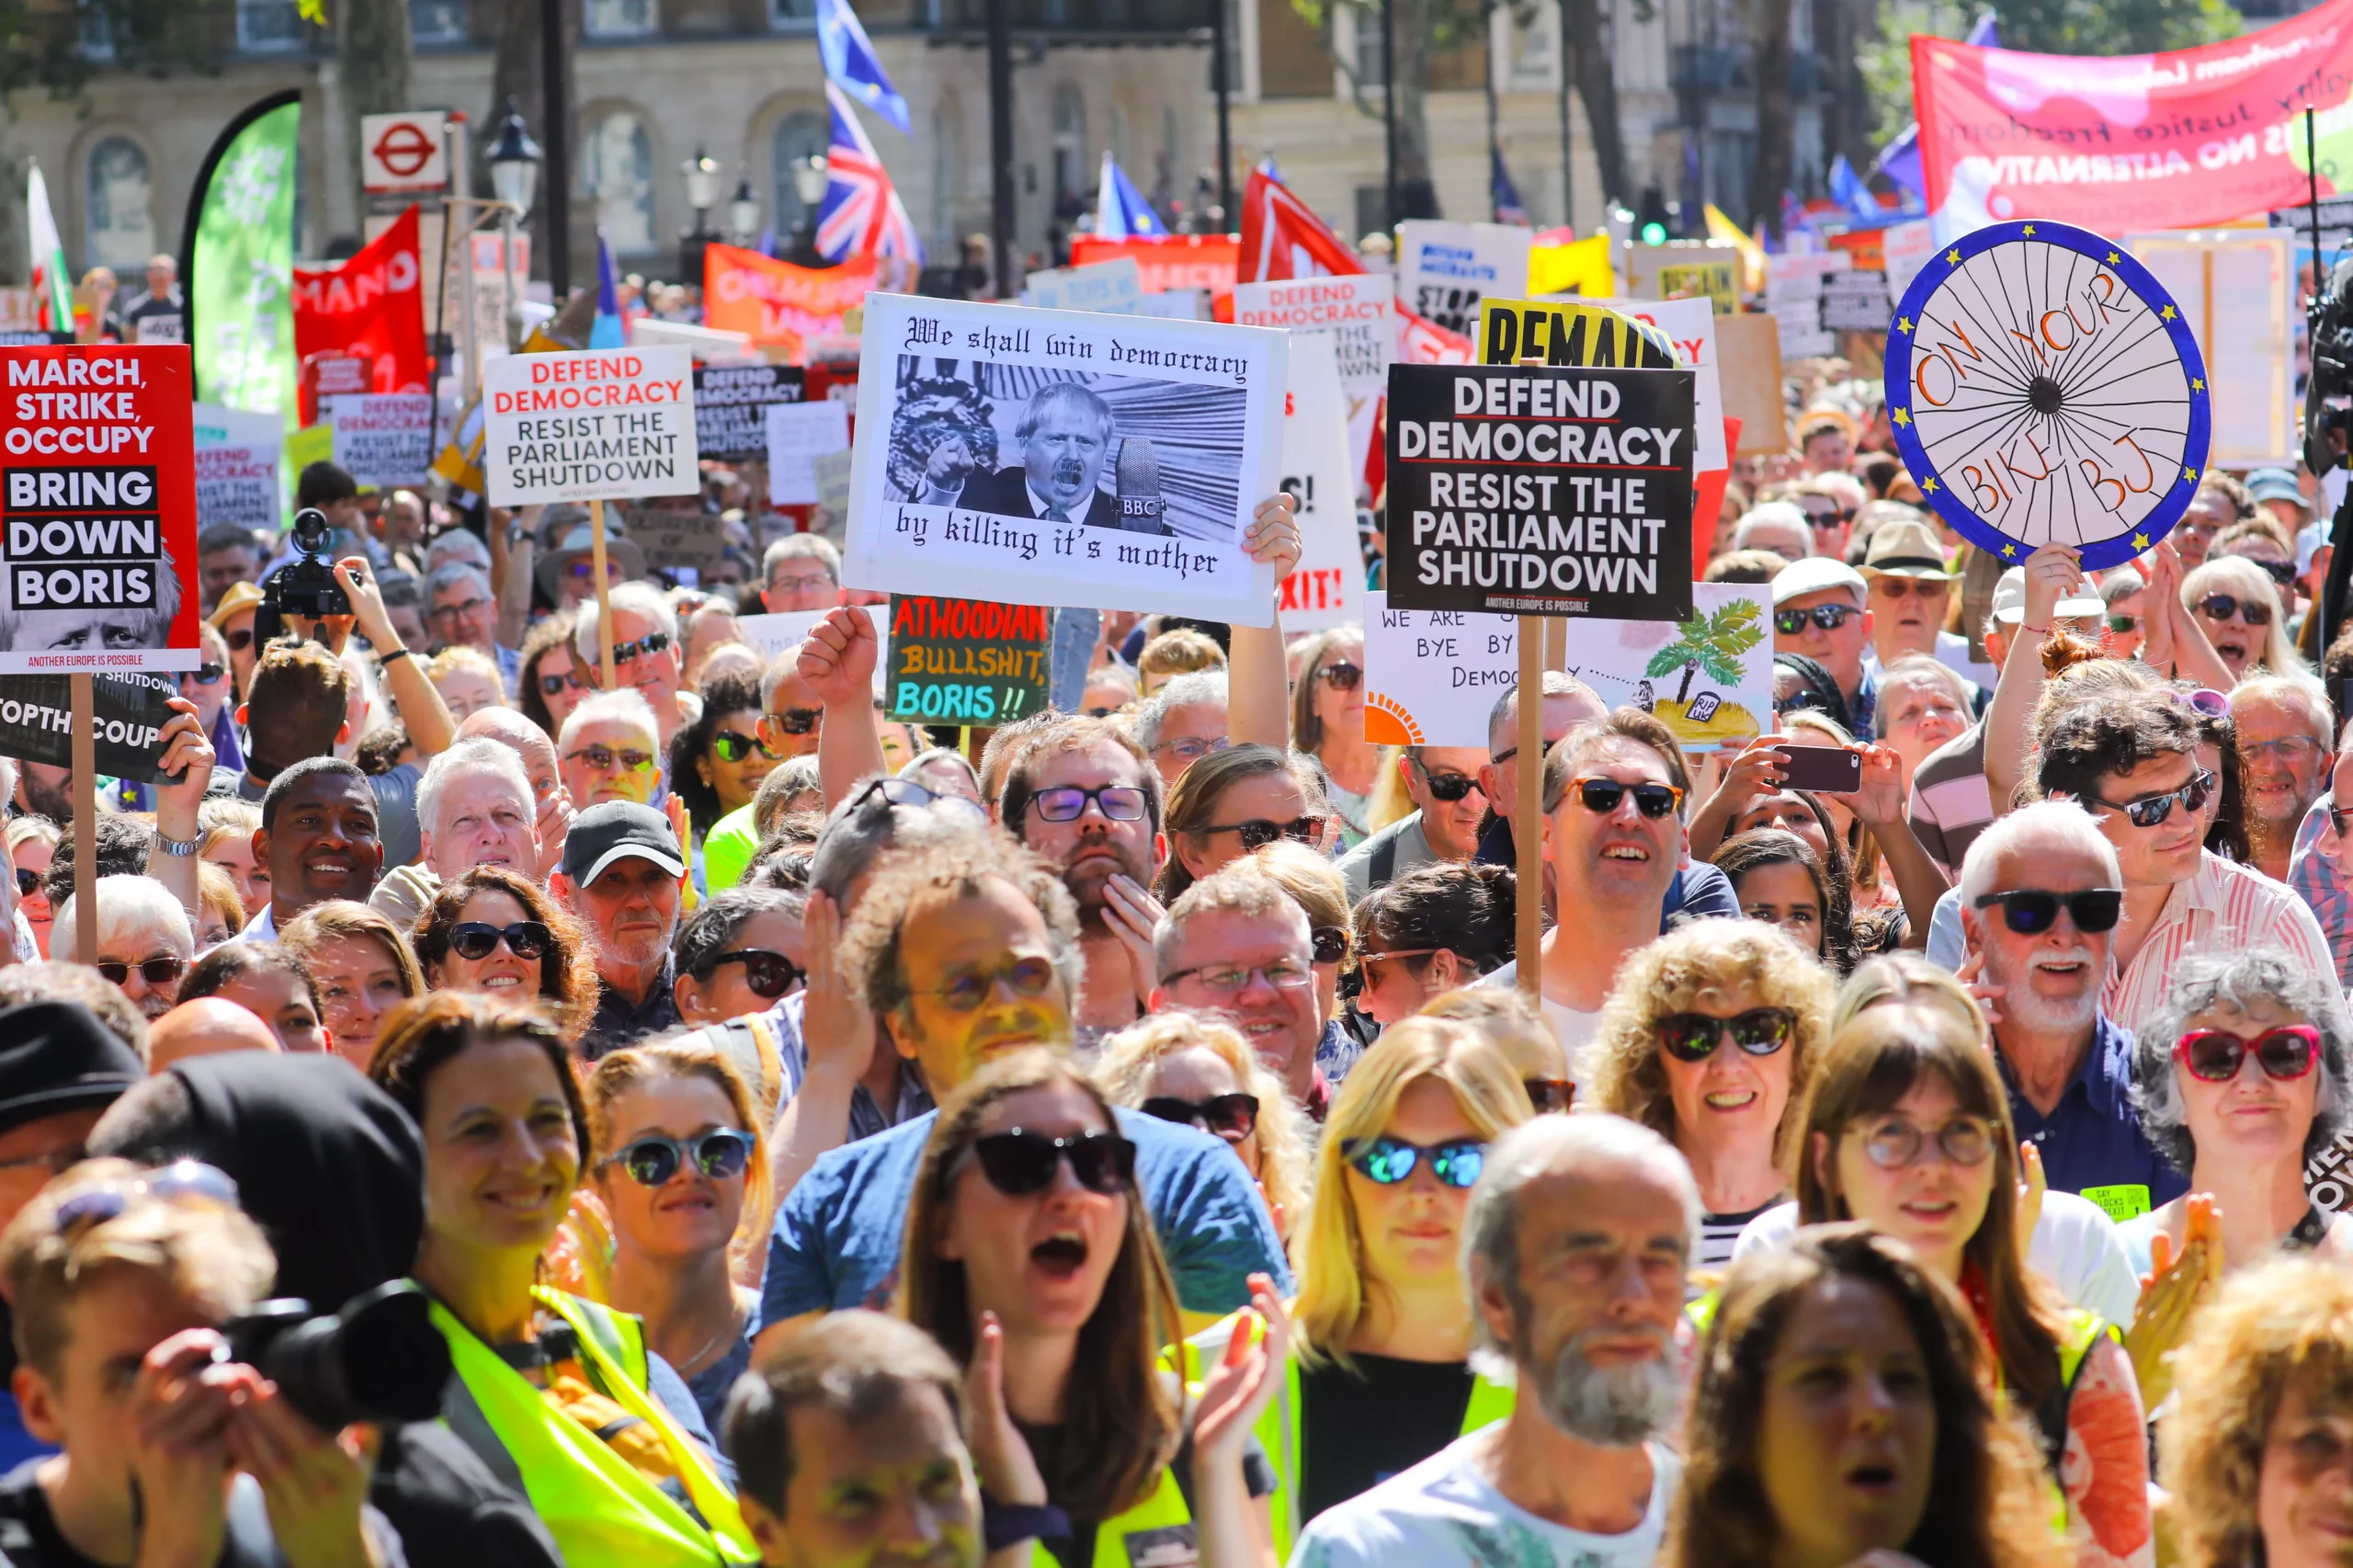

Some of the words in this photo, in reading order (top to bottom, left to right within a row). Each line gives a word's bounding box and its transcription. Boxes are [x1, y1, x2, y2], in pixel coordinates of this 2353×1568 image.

[1269, 282, 1356, 306] DEFEND
[1243, 301, 1386, 327] DEMOCRACY
[904, 315, 954, 351] We
[967, 324, 1031, 359] shall
[1045, 333, 1094, 359] win
[1109, 338, 1248, 385] democracy
[1916, 320, 1983, 407] ON
[2010, 273, 2131, 369] YOUR
[8, 358, 147, 389] MARCH,
[531, 356, 642, 384] DEFEND
[703, 368, 777, 389] DEFEND
[16, 392, 141, 423] STRIKE,
[494, 380, 683, 414] DEMOCRACY
[694, 383, 801, 406] EMOCRACY
[1454, 377, 1621, 419] DEFEND
[5, 426, 154, 454] OCCUPY
[518, 415, 604, 441] RESIST
[614, 412, 664, 435] THE
[508, 435, 678, 465] PARLIAMENT
[1399, 420, 1683, 466] DEMOCRACY
[512, 458, 675, 489] SHUTDOWN
[1961, 422, 2066, 514] BIKE
[2079, 426, 2138, 514] BJ
[10, 471, 153, 507] BRING
[1430, 472, 1558, 511] RESIST
[1570, 476, 1645, 514] THE
[1123, 499, 1156, 515] BBC
[9, 520, 154, 556] DOWN
[895, 506, 929, 546] by
[944, 510, 1039, 560] killing
[1052, 528, 1102, 559] it's
[1117, 540, 1219, 581] mother
[1413, 510, 1665, 554] PARLIAMENT
[17, 568, 152, 606] BORIS
[1417, 550, 1657, 594] SHUTDOWN
[1279, 568, 1343, 611] XIT!
[1485, 597, 1515, 609] ANOTHER
[1516, 598, 1544, 610] EUROPE
[1545, 600, 1553, 610] IS
[1554, 600, 1589, 612] POSSIBLE
[891, 596, 1048, 642] ATWOODIAN
[1382, 610, 1410, 628] WE
[1429, 611, 1465, 627] ARE
[28, 656, 64, 667] ANOTHER
[66, 655, 97, 666] EUROPE
[98, 655, 106, 665] IS
[107, 654, 143, 665] POSSIBLE
[1416, 638, 1460, 658] BYE
[1487, 634, 1518, 654] BY
[900, 644, 1045, 687] BULLSHIT,
[106, 672, 178, 698] SHUTDOWN
[894, 682, 995, 720] BORIS
[1693, 709, 1711, 721] UK
[1694, 698, 1715, 712] RIP
[2097, 1189, 2111, 1199] SAY
